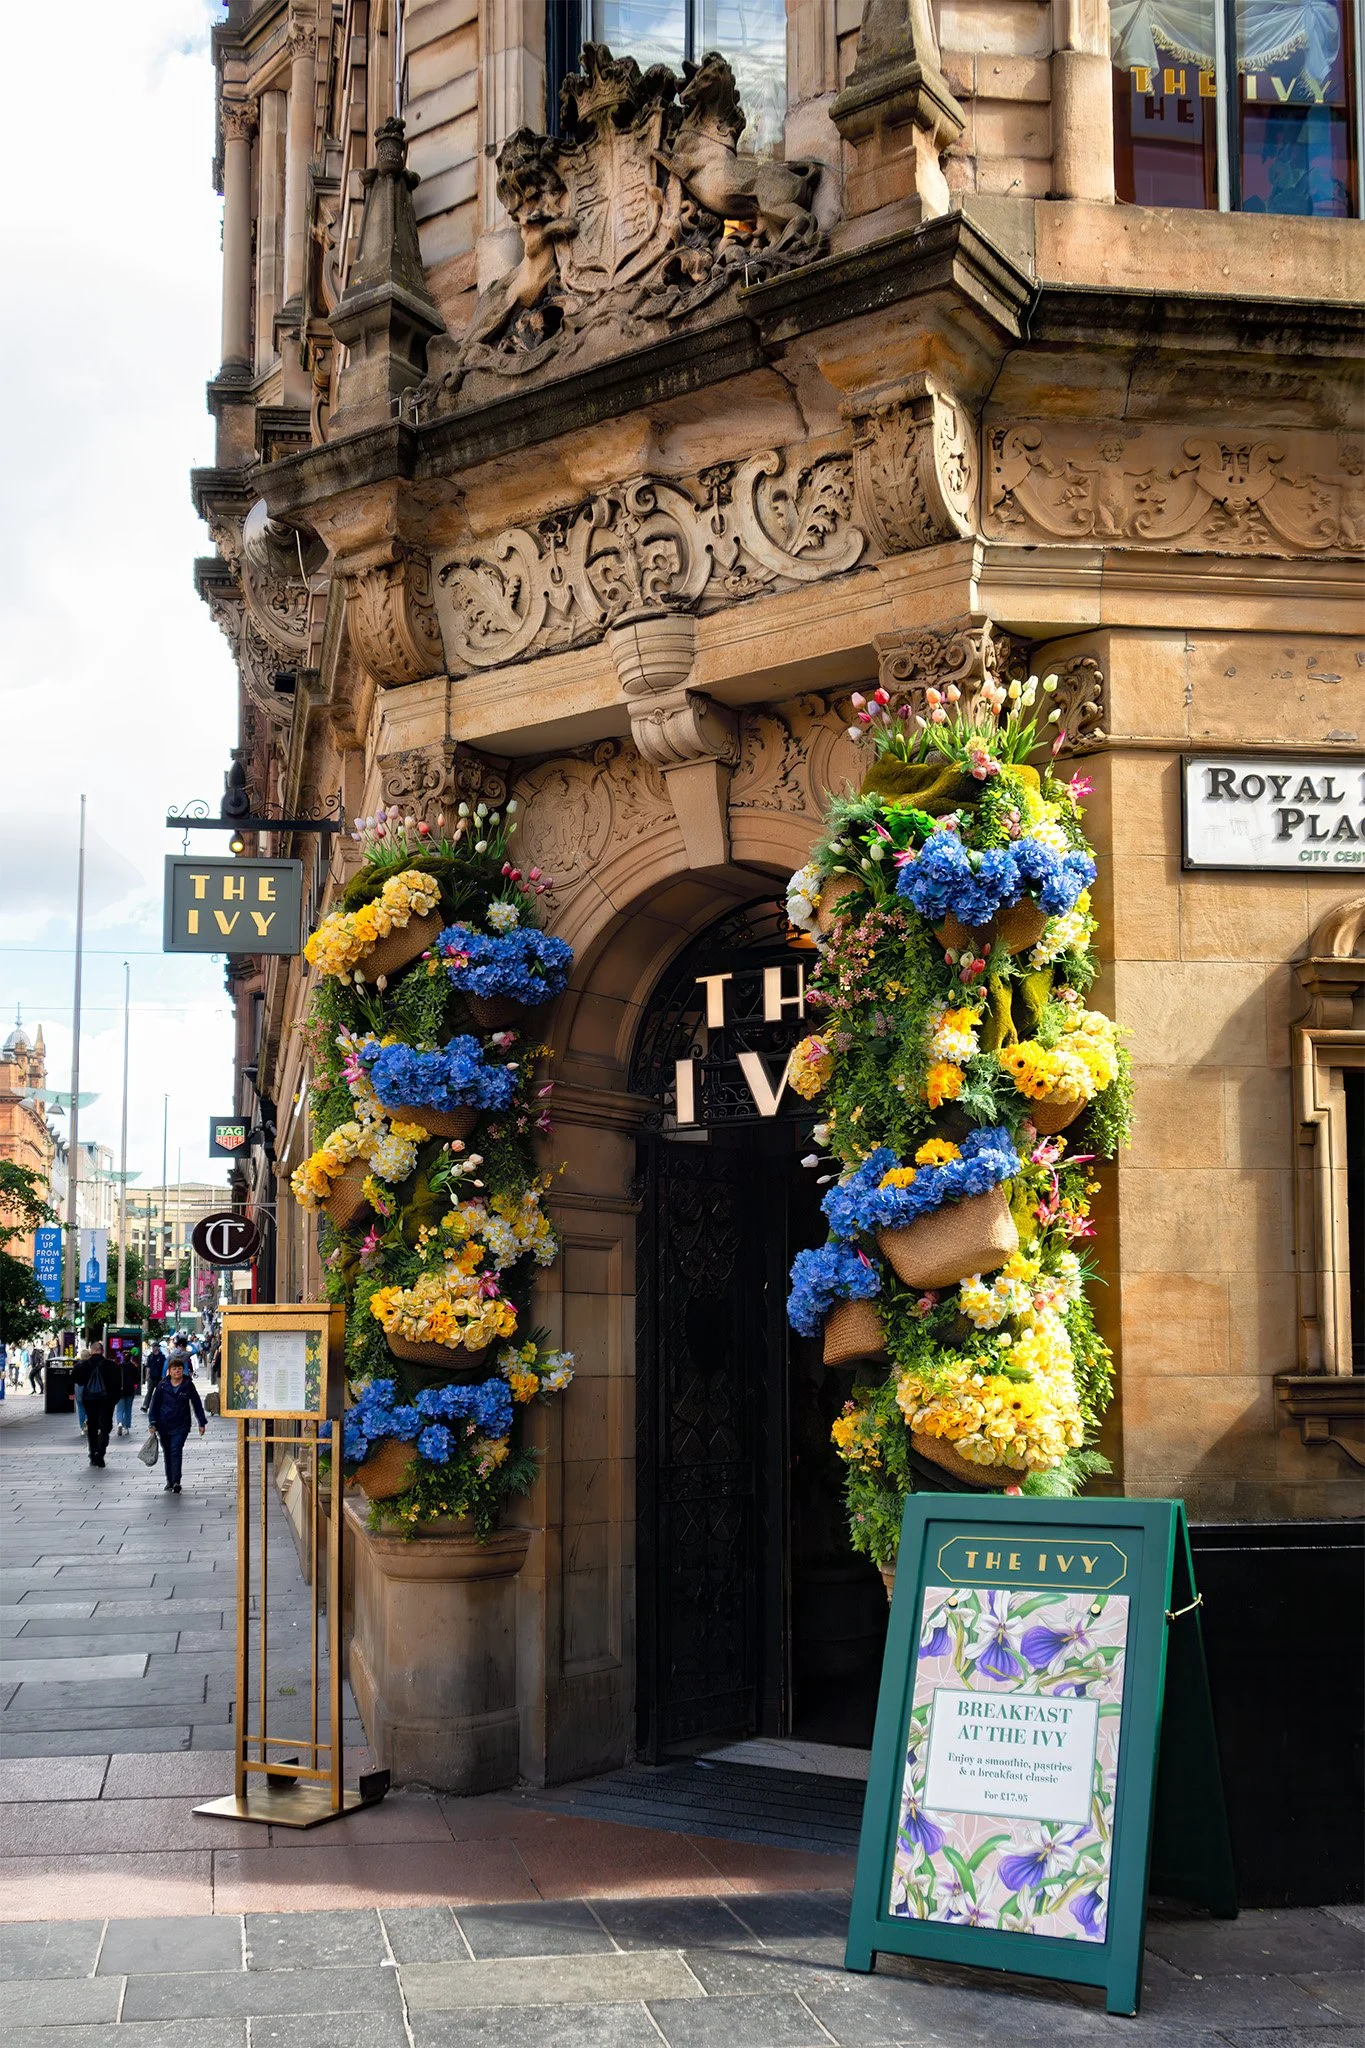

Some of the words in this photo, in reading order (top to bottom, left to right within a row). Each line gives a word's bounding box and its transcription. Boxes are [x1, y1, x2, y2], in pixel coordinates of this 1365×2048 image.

[1131, 66, 1216, 97] THE
[1247, 75, 1331, 103] IVY
[1207, 768, 1345, 803] ROYAL
[1277, 808, 1365, 839] PLA
[1300, 850, 1330, 861] CITY
[1334, 851, 1365, 862] CEN
[189, 874, 276, 901] THE
[188, 909, 276, 936] IVY
[695, 963, 805, 1029] TH
[675, 1049, 795, 1124] IV
[216, 1136, 244, 1149] HEUER
[217, 1127, 242, 1135] TAG
[965, 1551, 1021, 1571] THE
[1038, 1554, 1099, 1574] IVY
[957, 1700, 1073, 1725] BREAKFAST
[957, 1724, 984, 1741] AT
[985, 1726, 1027, 1745] THE
[1032, 1730, 1068, 1748] IVY
[948, 1752, 974, 1765] Enjoy
[985, 1757, 1031, 1769] smoothie,
[1033, 1761, 1073, 1773] pastries
[959, 1766, 967, 1776] &
[978, 1768, 1023, 1781] breakfast
[1025, 1772, 1059, 1784] classic
[984, 1791, 998, 1800] For
[1000, 1792, 1028, 1803] £17.95
